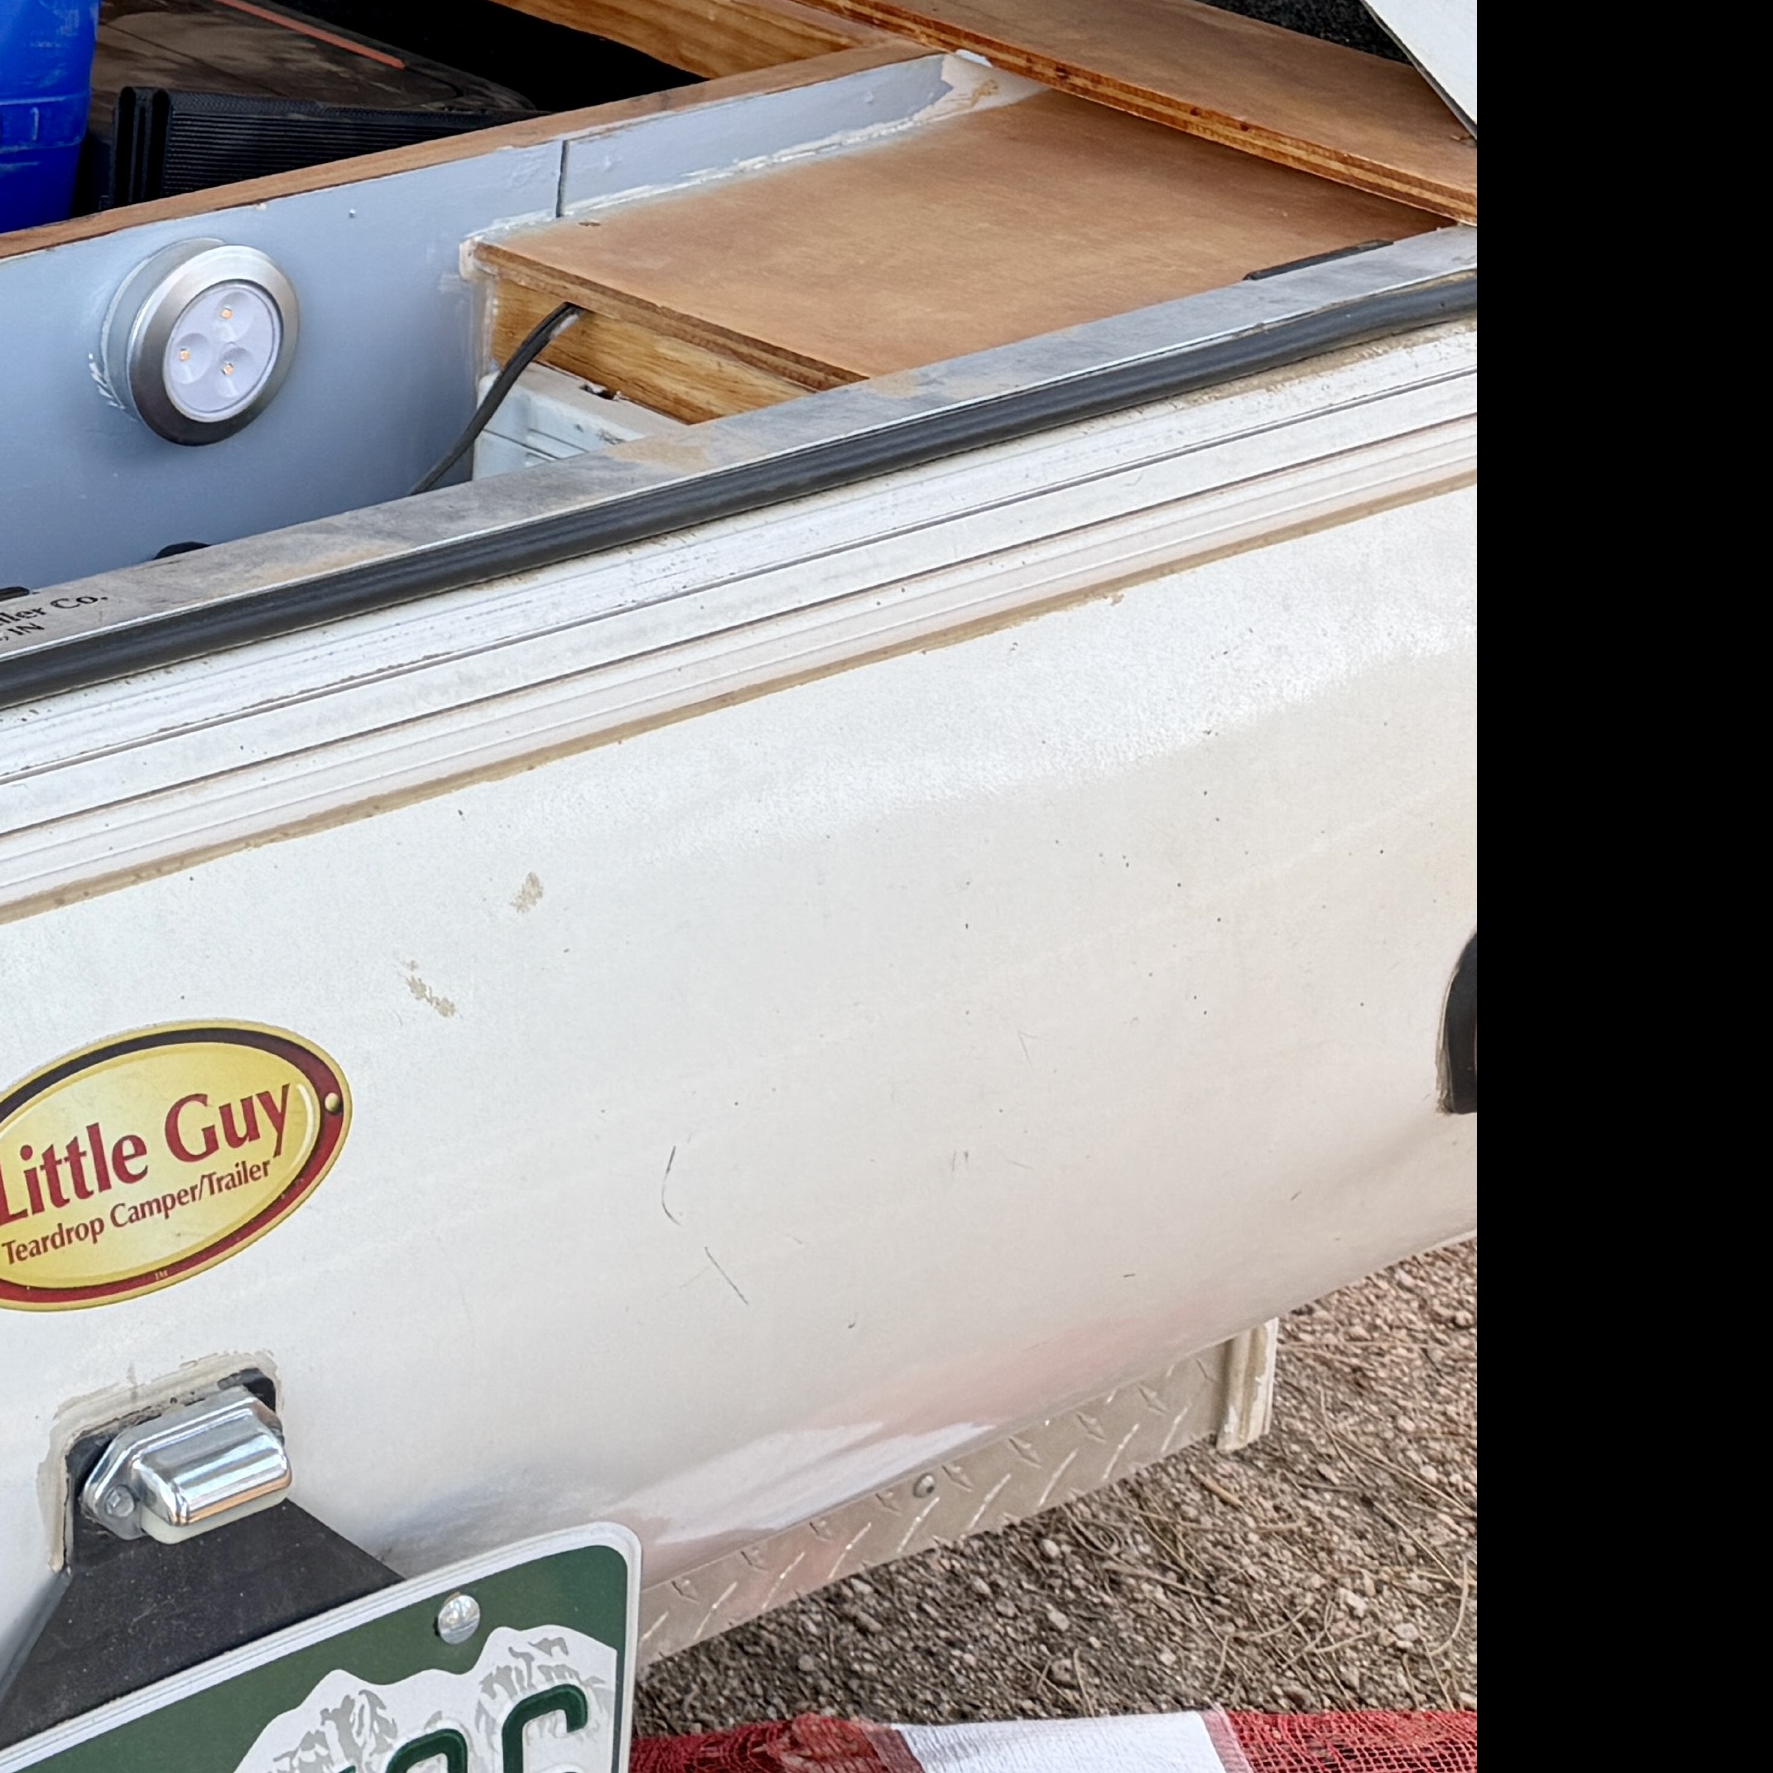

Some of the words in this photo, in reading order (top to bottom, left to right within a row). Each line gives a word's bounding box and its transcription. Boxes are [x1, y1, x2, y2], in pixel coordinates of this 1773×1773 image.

[50, 595, 109, 609] Co.
[7, 621, 46, 636] IN
[164, 1083, 291, 1164] Guy
[0, 1217, 105, 1266] Teardrop
[109, 1158, 272, 1229] Camper/Trailer
